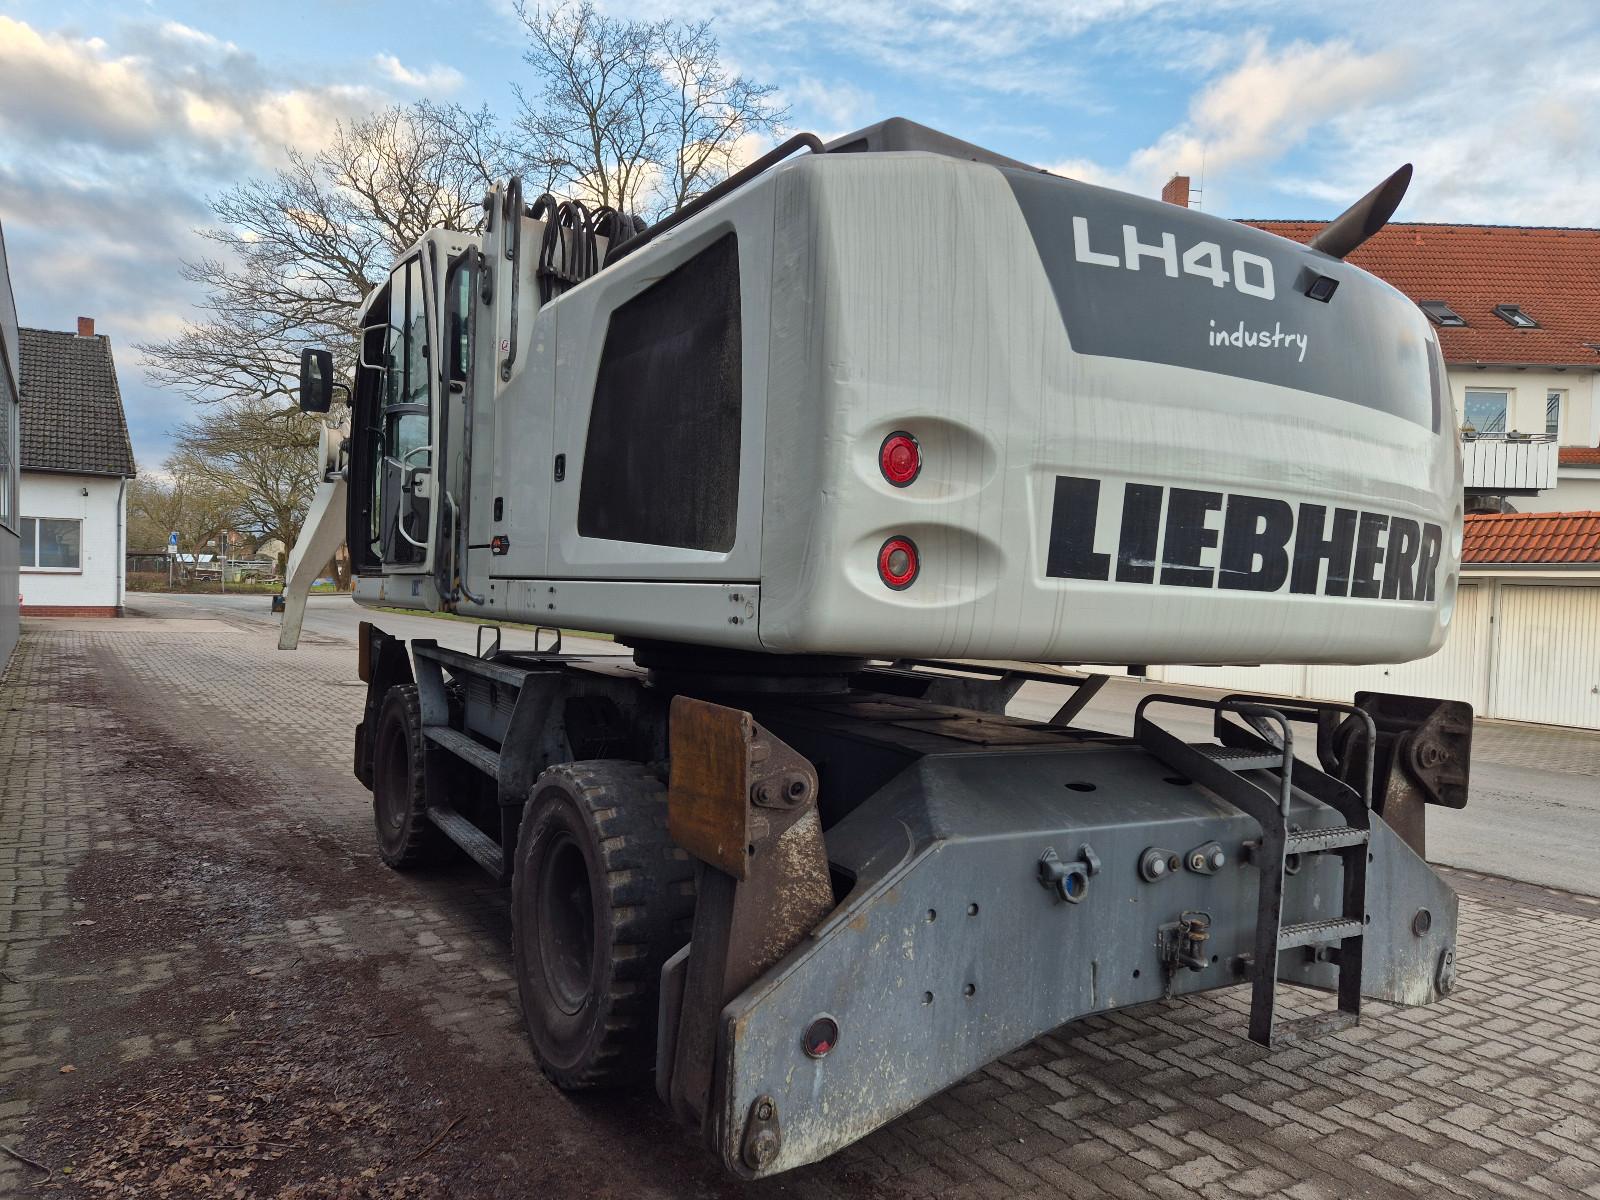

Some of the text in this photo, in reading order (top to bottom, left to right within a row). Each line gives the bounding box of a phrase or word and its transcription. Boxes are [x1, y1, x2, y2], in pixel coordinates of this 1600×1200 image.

[1072, 216, 1275, 300] LH40
[1208, 319, 1308, 363] industry
[1046, 475, 1442, 602] LIEBHERR
